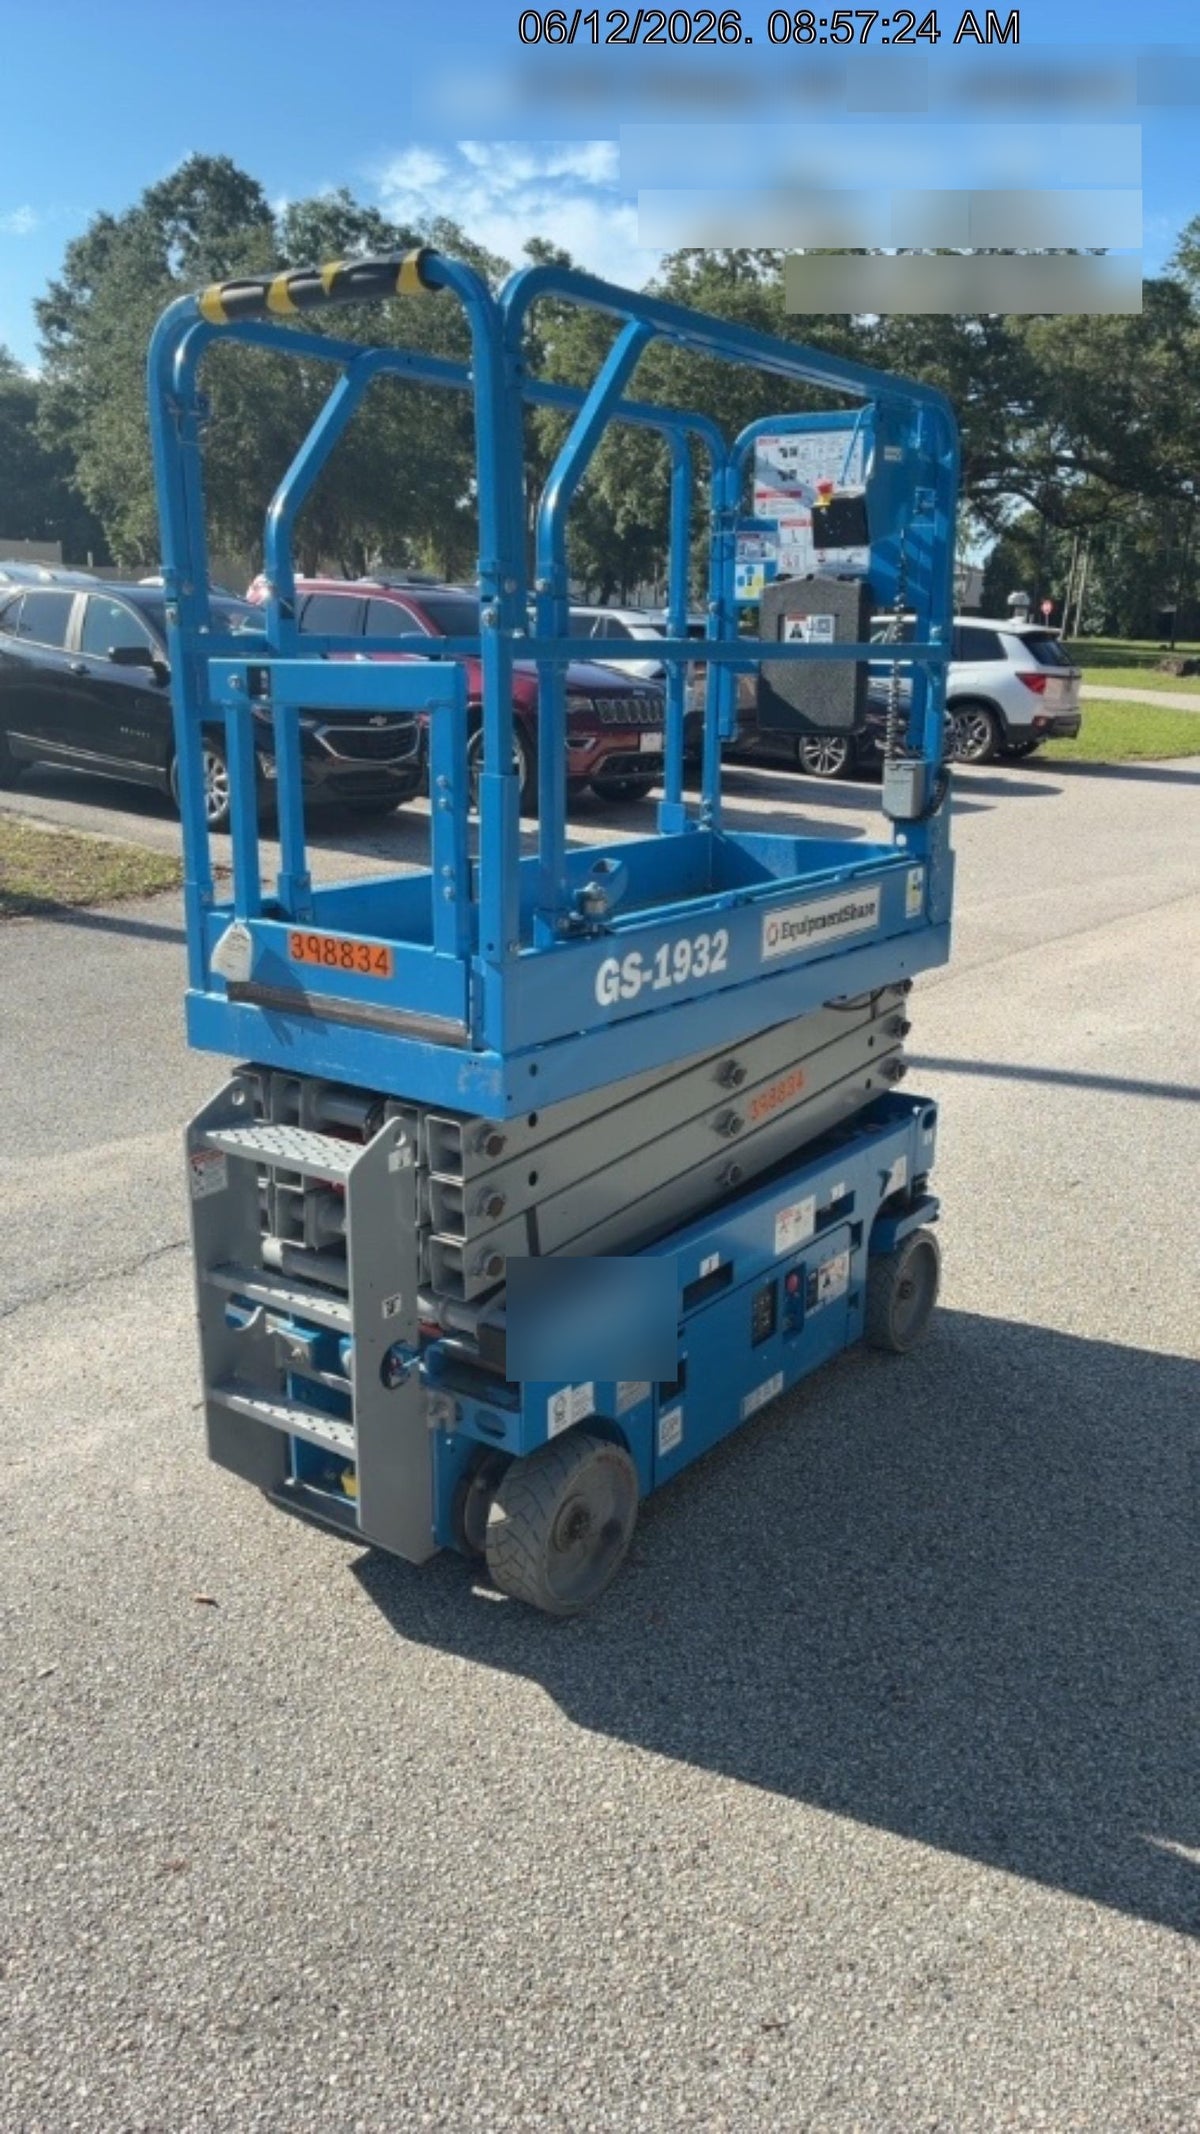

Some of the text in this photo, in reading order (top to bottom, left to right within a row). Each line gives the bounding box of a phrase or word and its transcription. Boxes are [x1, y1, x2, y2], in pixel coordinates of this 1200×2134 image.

[780, 898, 877, 942] EquipmentShare
[290, 931, 390, 977] 398834
[595, 928, 730, 1007] GS-1932
